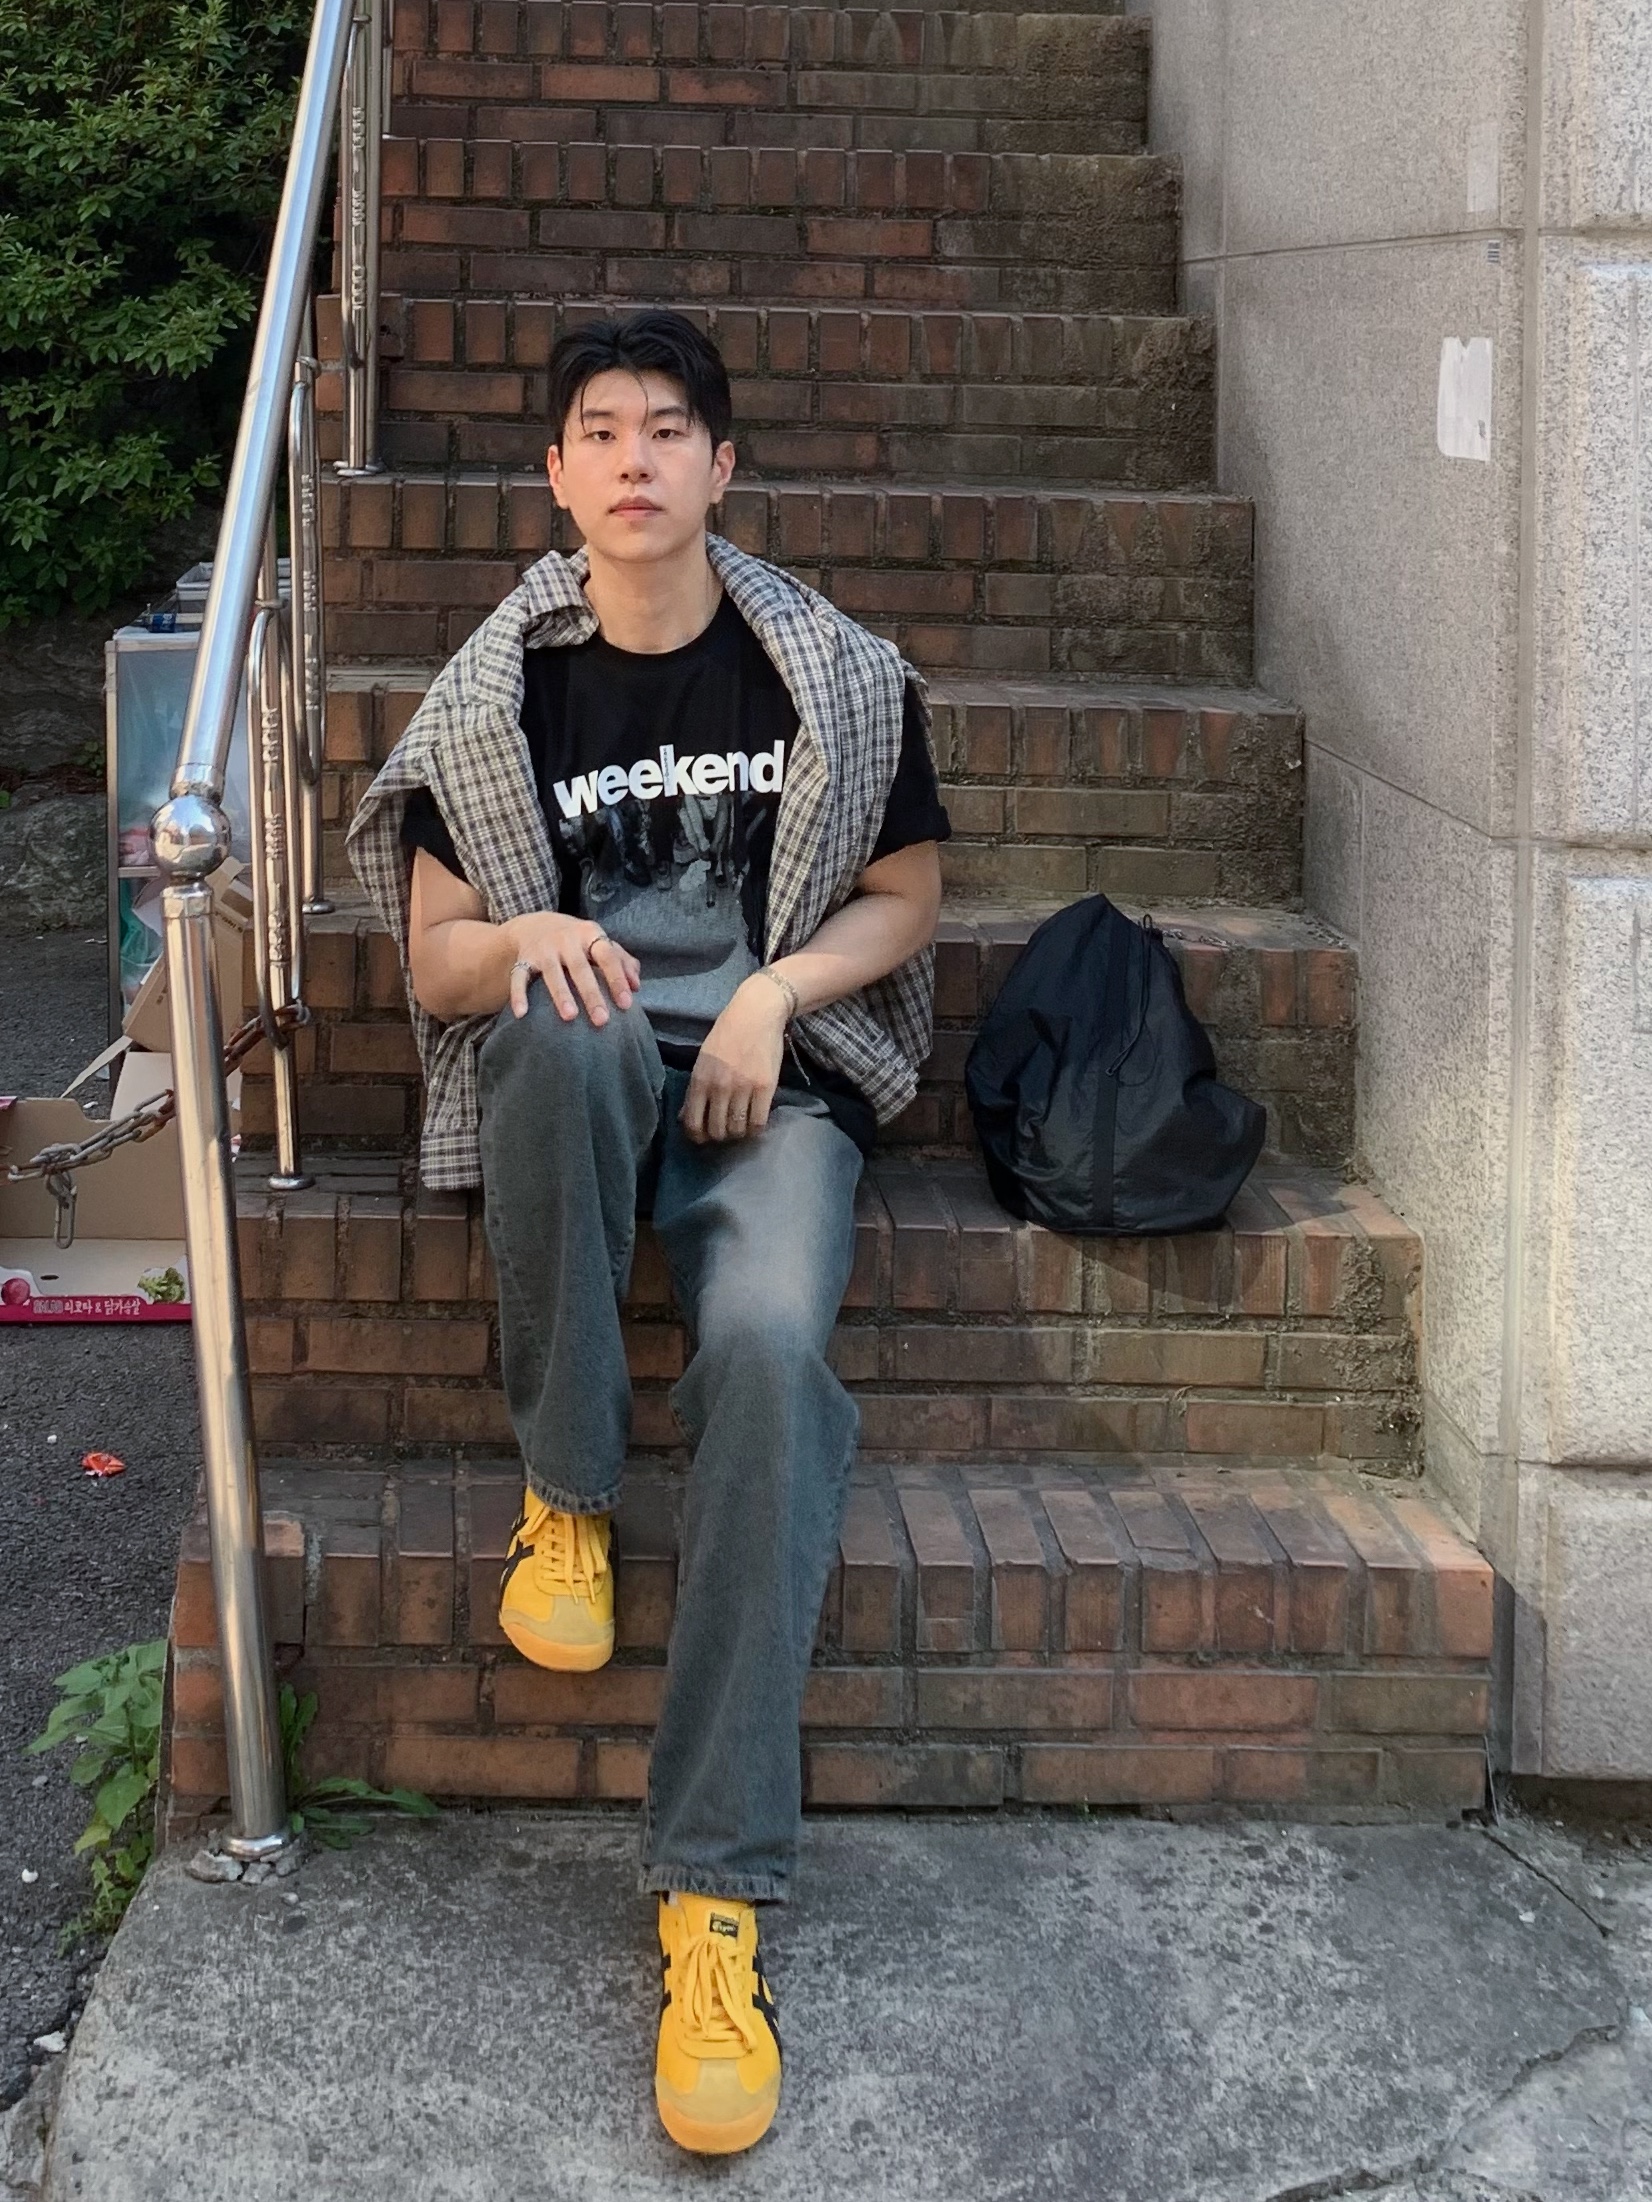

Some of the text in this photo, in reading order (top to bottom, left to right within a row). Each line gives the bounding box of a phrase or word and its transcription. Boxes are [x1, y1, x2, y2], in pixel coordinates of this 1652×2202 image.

[553, 740, 785, 818] weekend
[64, 1299, 93, 1315] 리코타
[95, 1302, 102, 1314] &
